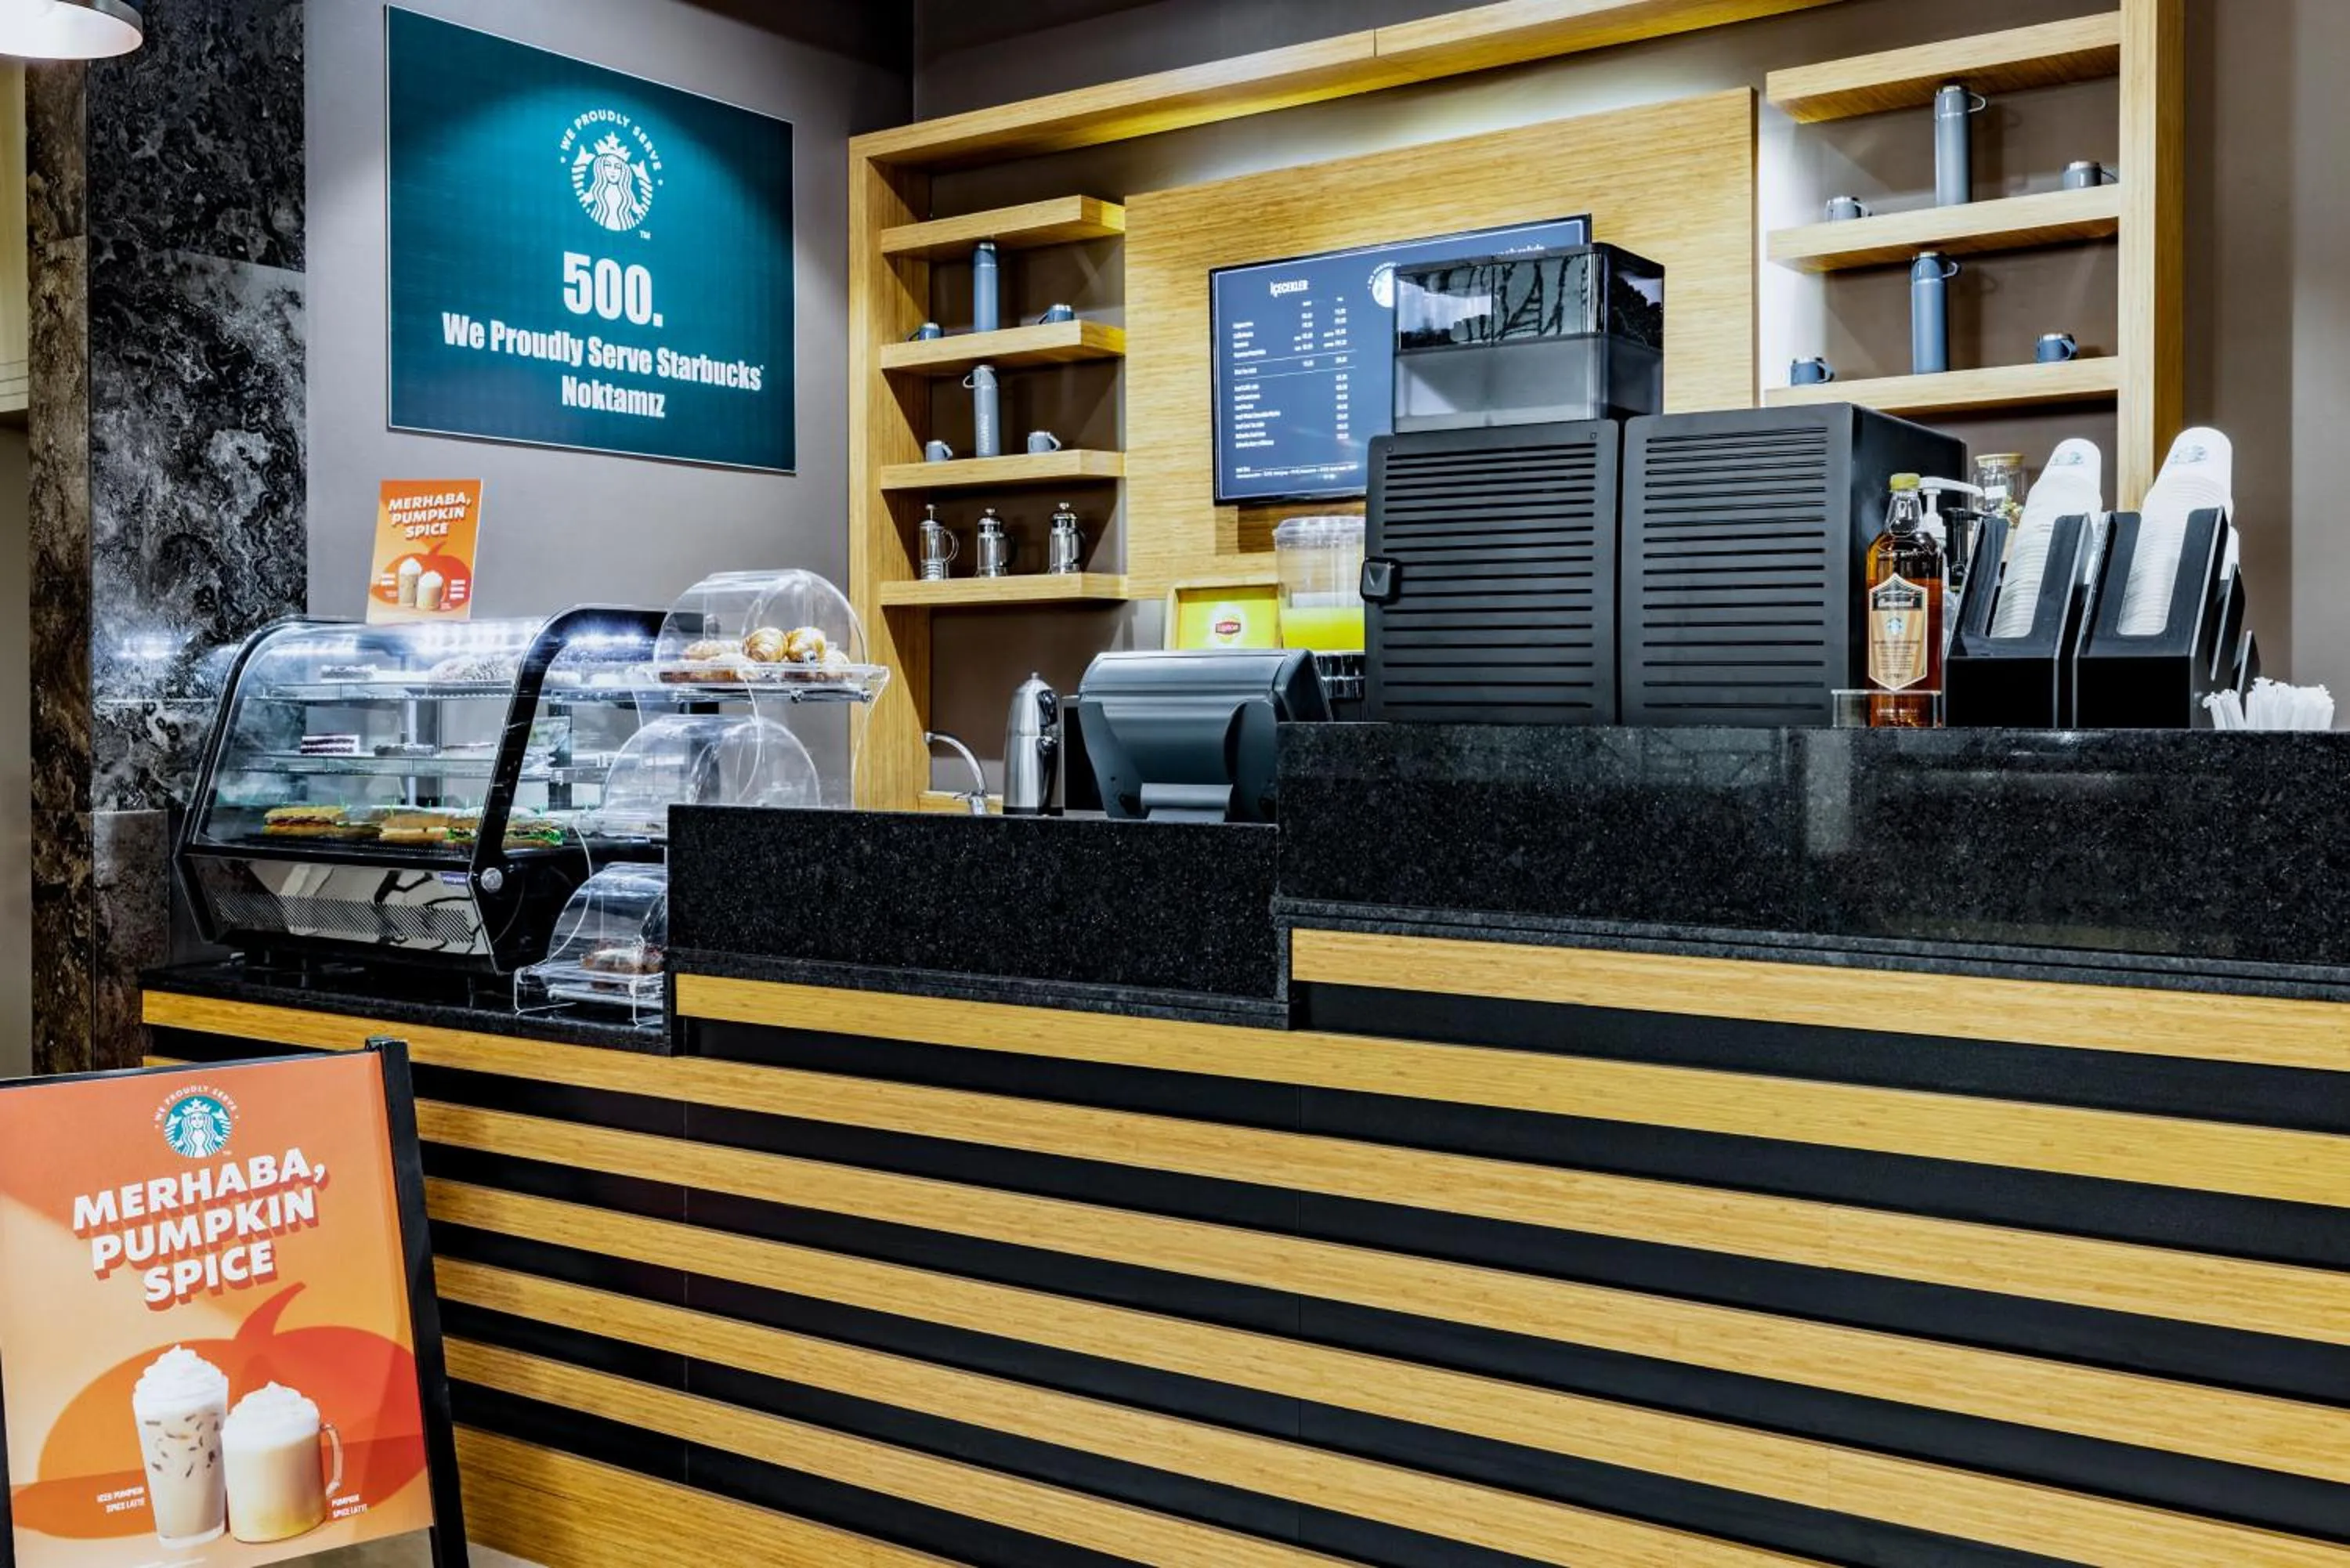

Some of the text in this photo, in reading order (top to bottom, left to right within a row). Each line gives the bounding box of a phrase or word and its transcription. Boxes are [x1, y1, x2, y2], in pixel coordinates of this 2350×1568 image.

[559, 109, 662, 171] WE PROUDLY SERVE
[562, 251, 663, 327] 500.
[441, 311, 485, 349] We
[490, 320, 584, 367] Proudly
[588, 336, 653, 375] Serve
[561, 375, 666, 418] Noktamız
[389, 491, 472, 511] MERHABA,
[392, 506, 465, 526] PUMPKIN
[405, 522, 449, 539] SPICE
[72, 1147, 327, 1234] MERHABA,
[91, 1186, 315, 1274] PUMPKIN
[143, 1239, 276, 1306] SPICE
